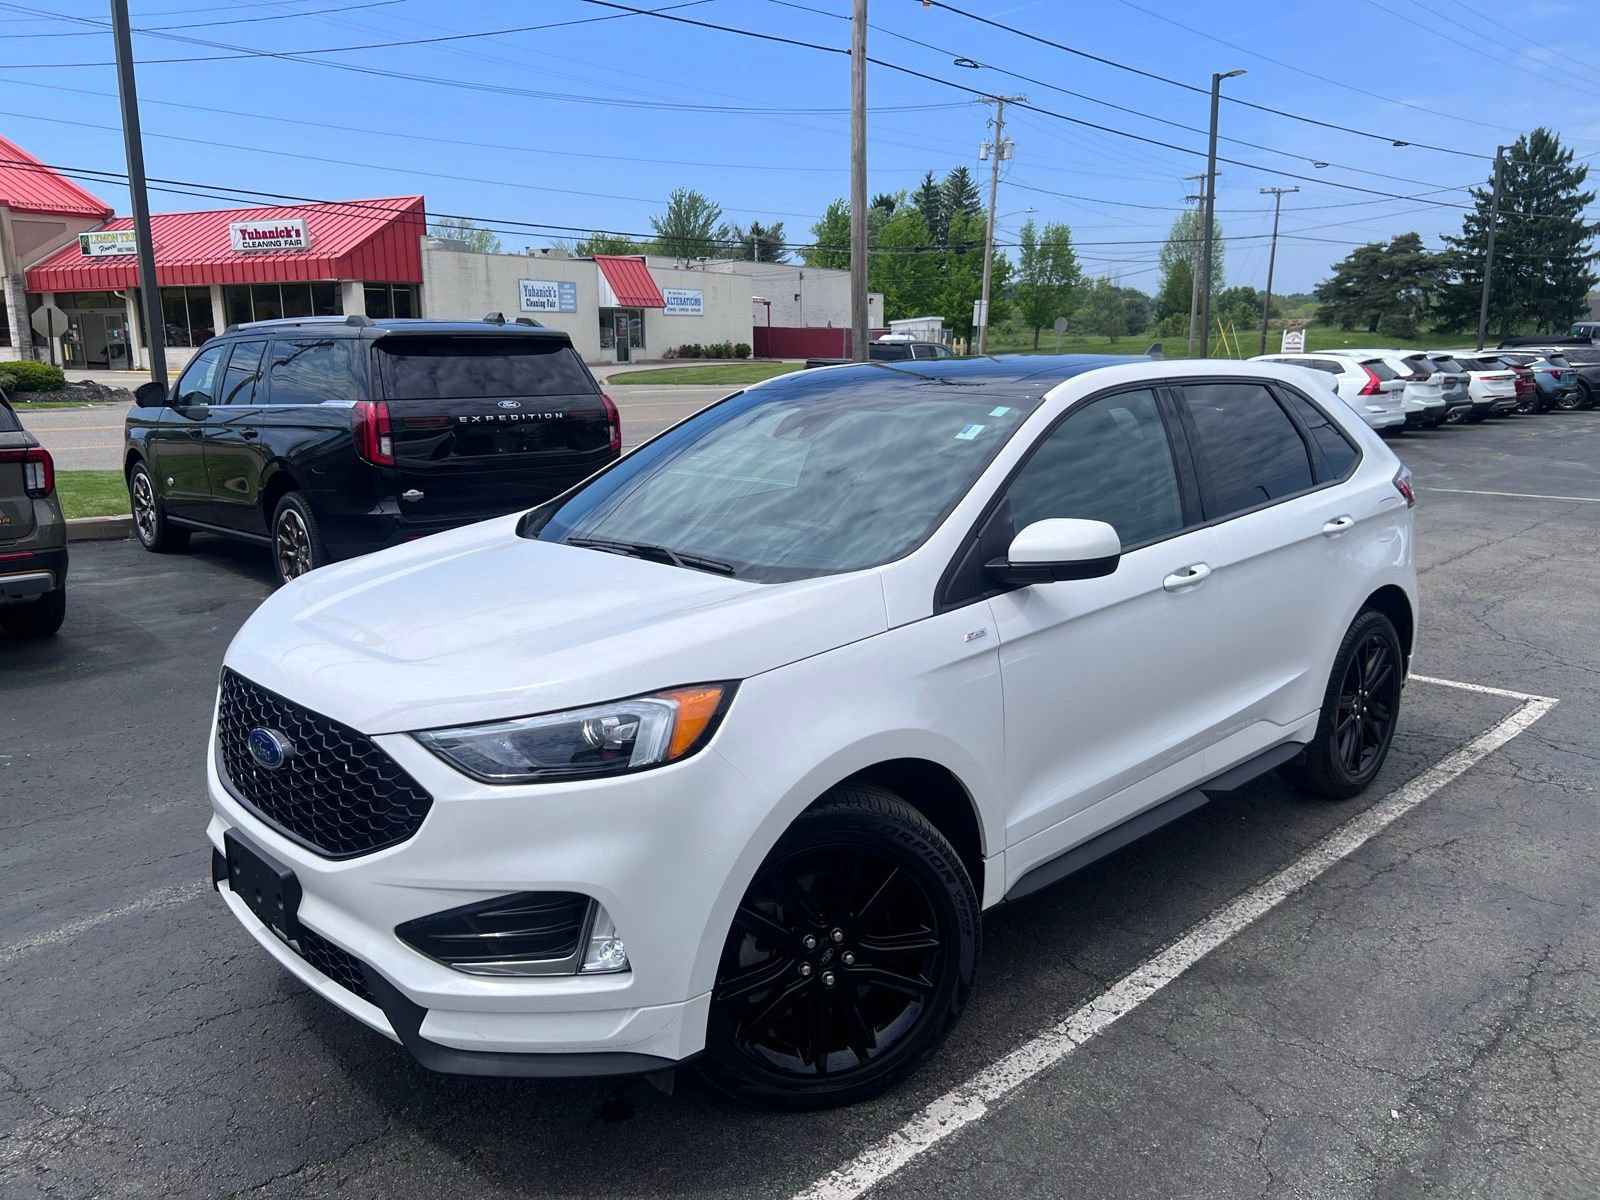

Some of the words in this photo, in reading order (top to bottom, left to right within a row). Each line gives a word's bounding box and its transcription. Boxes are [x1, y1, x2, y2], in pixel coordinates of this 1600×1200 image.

[119, 232, 136, 242] TRE
[240, 226, 301, 240] Yuhanick's
[523, 284, 557, 298] Yuhanick's
[526, 298, 546, 309] Cleaning
[546, 299, 556, 308] Fair
[666, 296, 702, 306] ALTERATIONS
[459, 413, 563, 423] EXPEDITION
